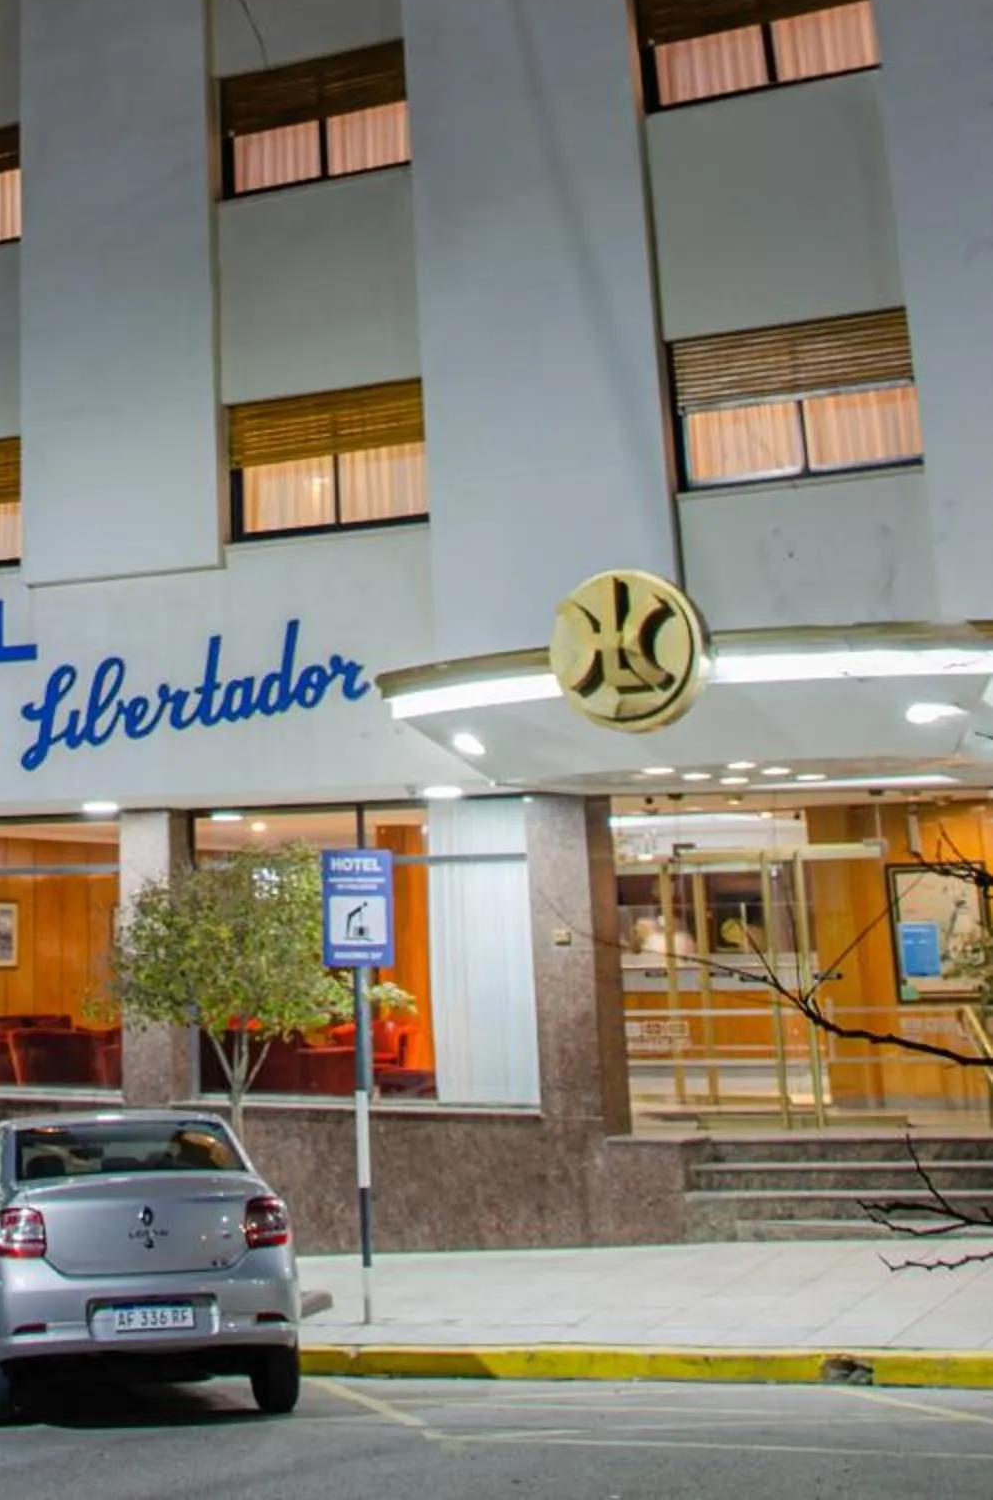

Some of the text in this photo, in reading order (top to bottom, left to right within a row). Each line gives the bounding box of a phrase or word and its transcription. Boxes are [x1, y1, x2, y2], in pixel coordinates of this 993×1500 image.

[20, 619, 370, 771] Libertador
[331, 857, 382, 871] HOTEL
[118, 1312, 135, 1327] AF
